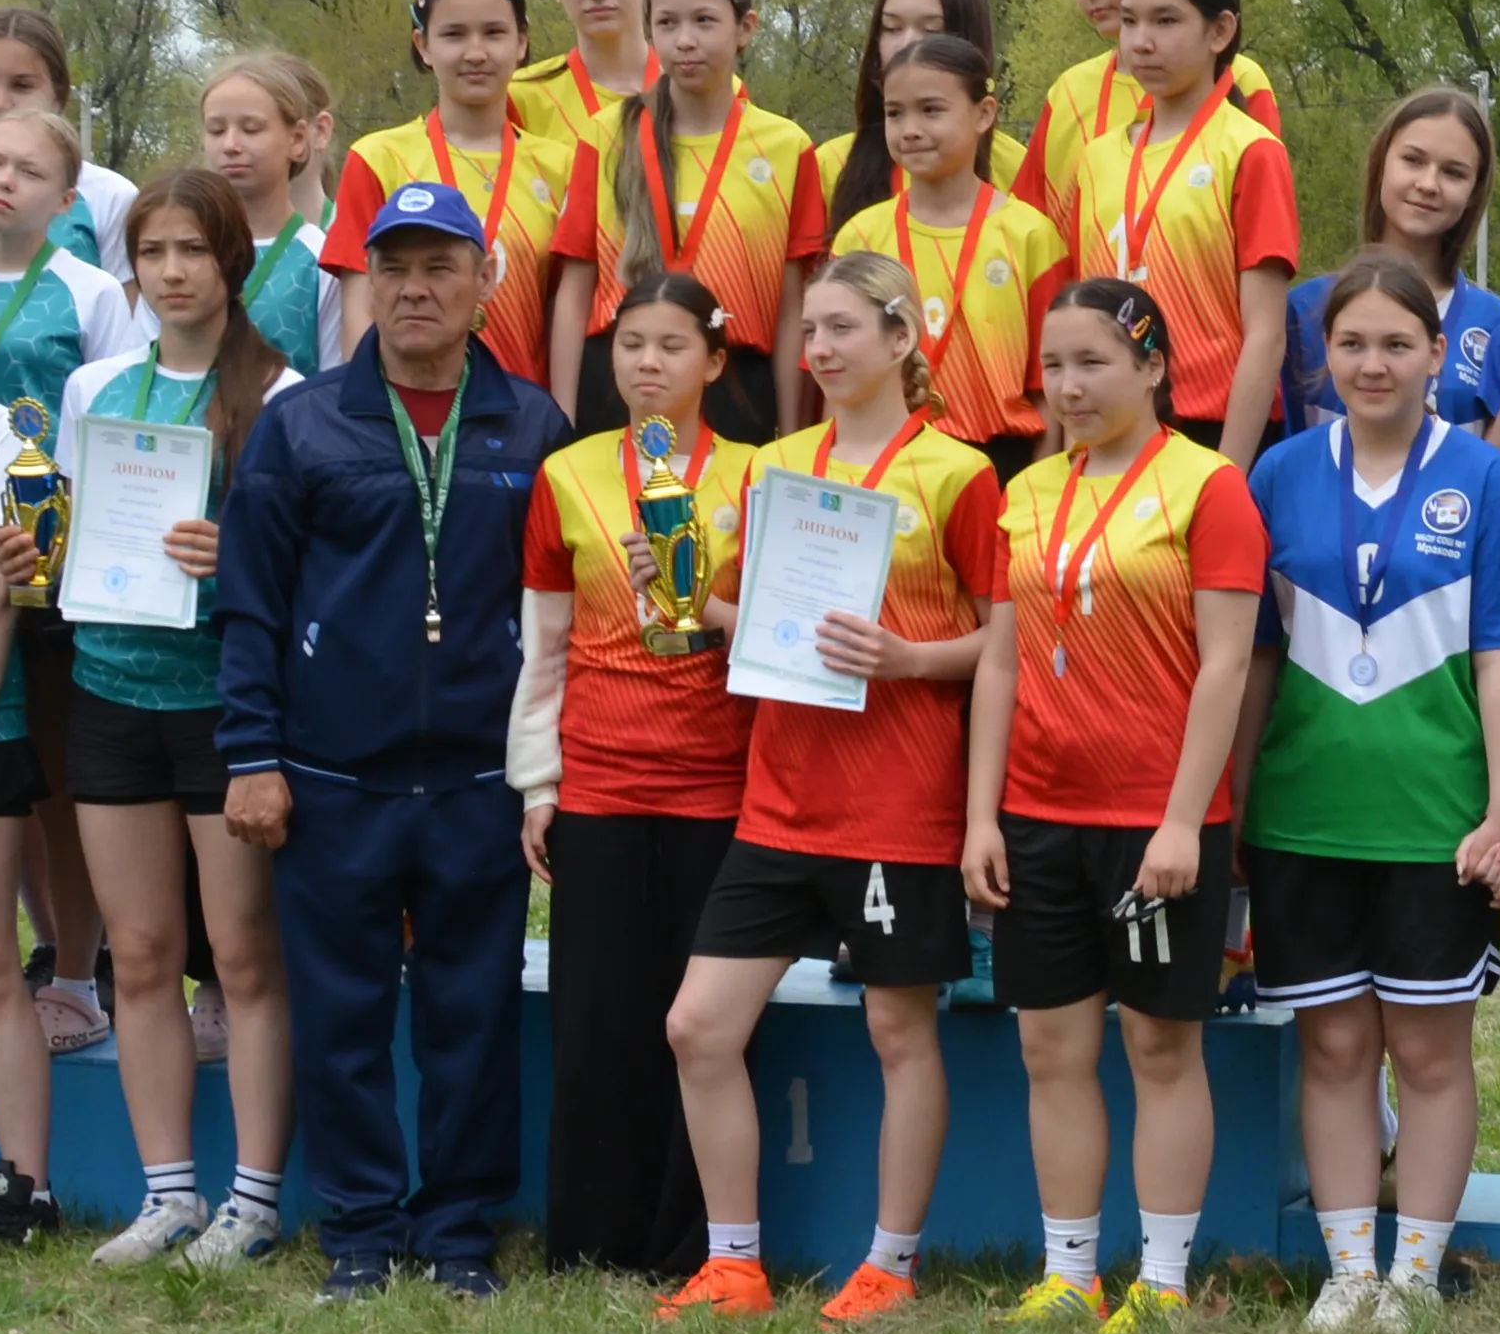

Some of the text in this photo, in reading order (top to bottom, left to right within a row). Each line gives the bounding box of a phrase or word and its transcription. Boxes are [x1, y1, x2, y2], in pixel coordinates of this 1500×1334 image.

[111, 462, 176, 481] ДИПЛОМ
[794, 518, 860, 544] ДИПЛОМ
[1416, 542, 1461, 559] Мраково
[864, 861, 896, 935] 4
[1112, 890, 1171, 963] 11
[786, 1076, 813, 1164] 1
